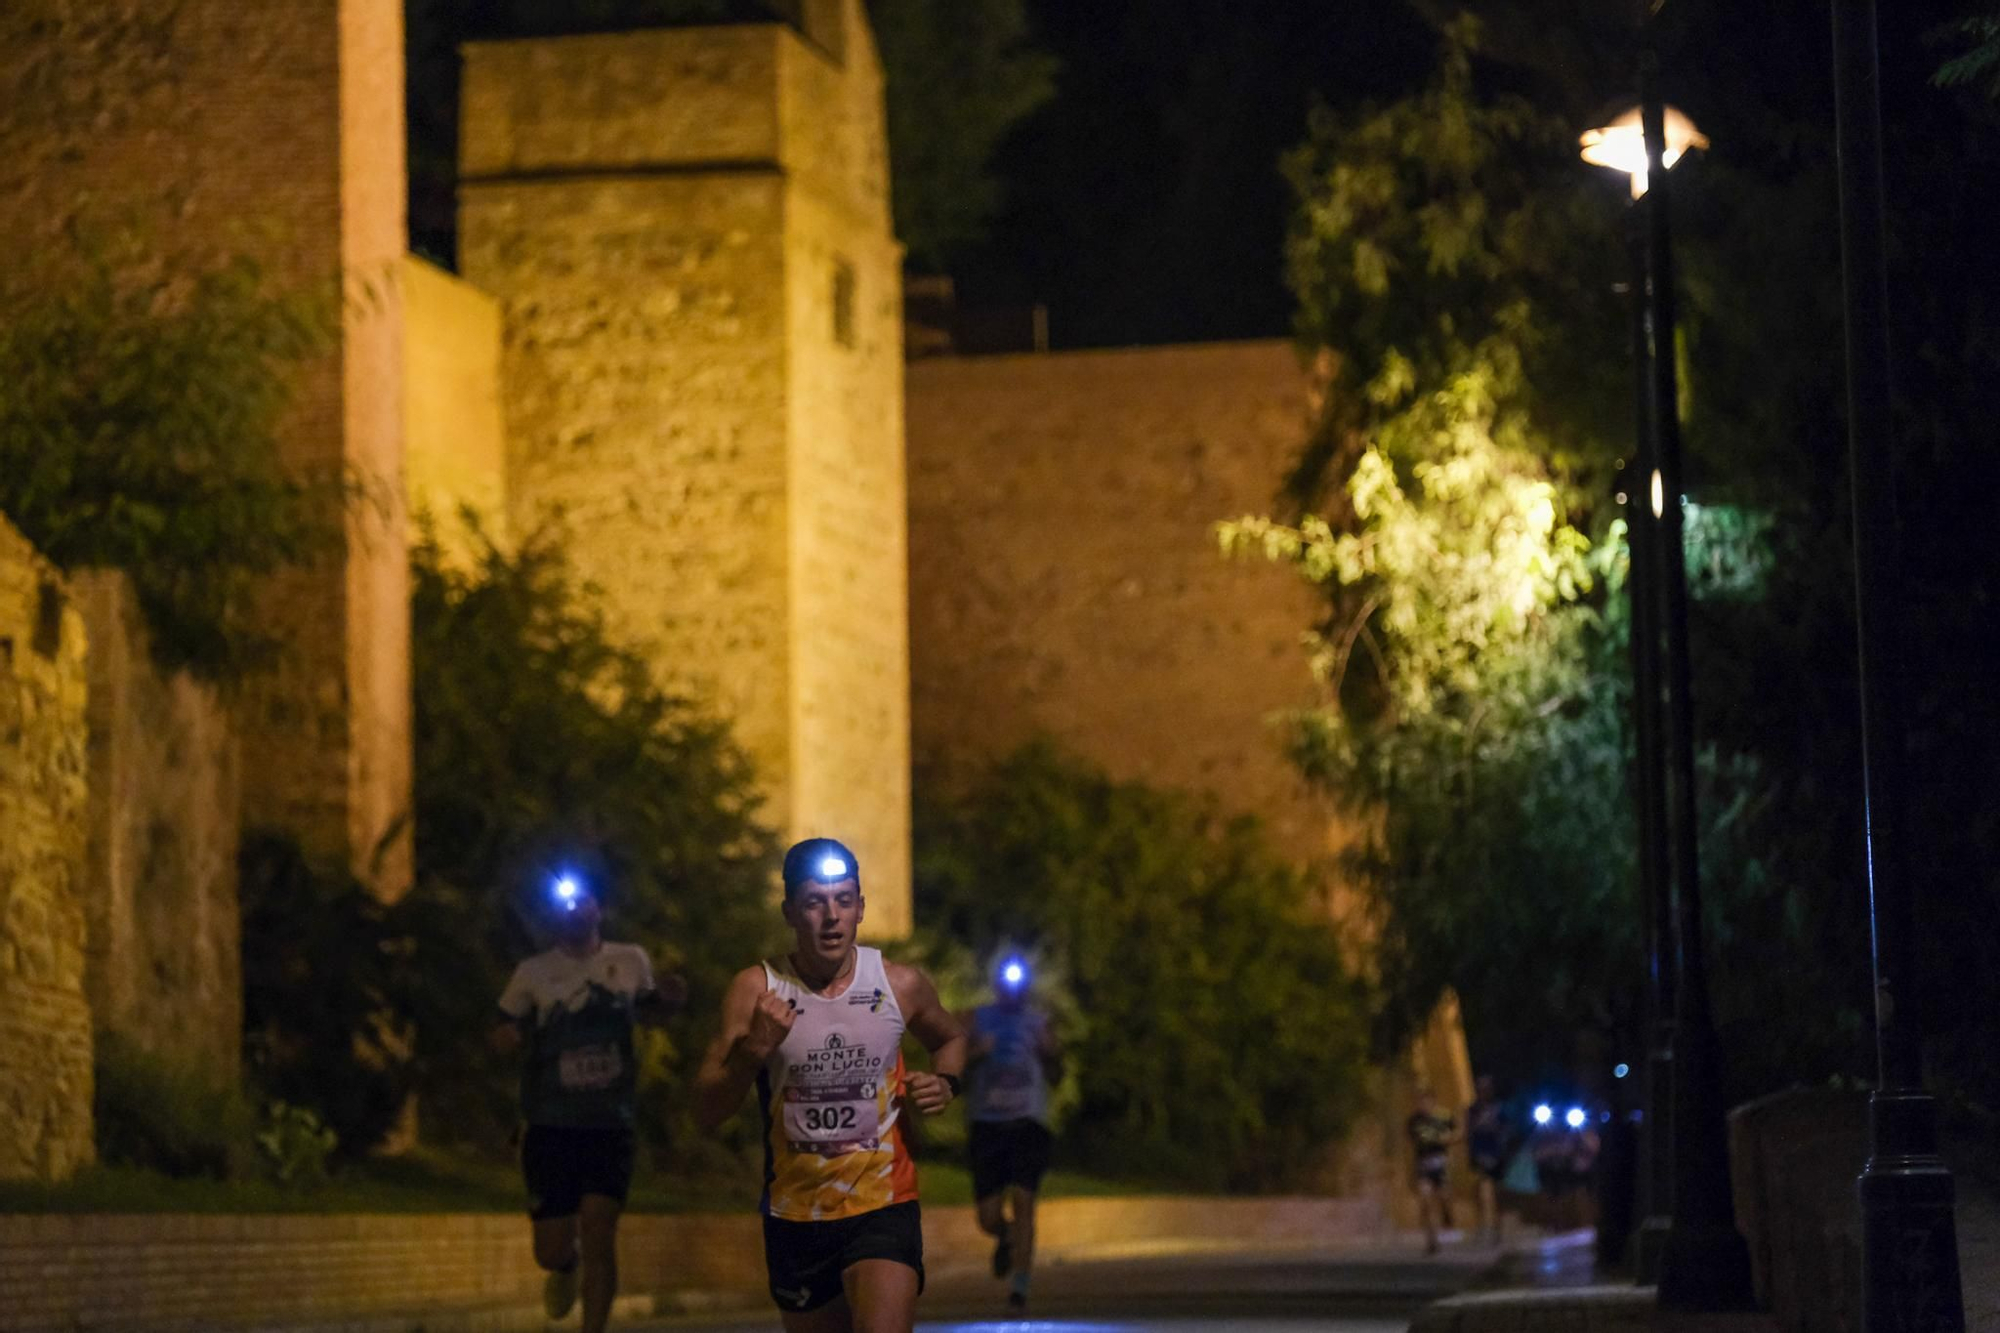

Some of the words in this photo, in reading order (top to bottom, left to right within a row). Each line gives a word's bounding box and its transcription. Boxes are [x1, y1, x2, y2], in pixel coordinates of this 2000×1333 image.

[807, 1047, 866, 1062] MONTE
[789, 1062, 823, 1073] DON
[832, 1057, 881, 1071] LUCIO
[805, 1106, 856, 1130] 302
